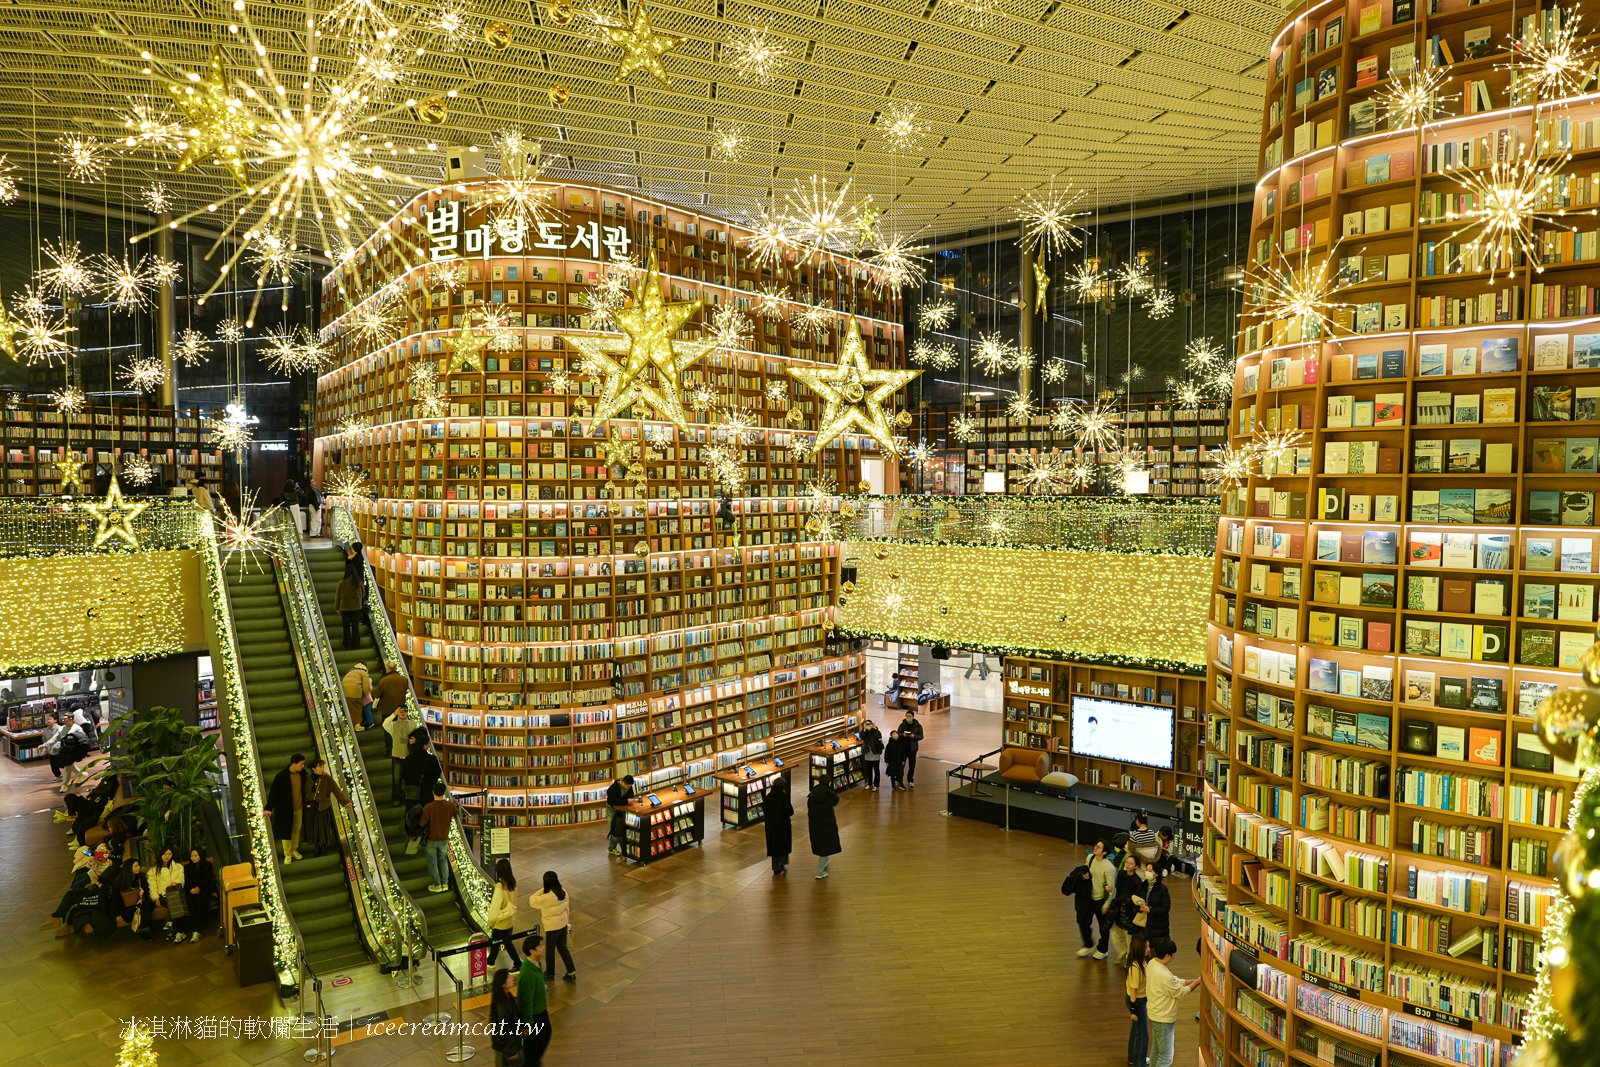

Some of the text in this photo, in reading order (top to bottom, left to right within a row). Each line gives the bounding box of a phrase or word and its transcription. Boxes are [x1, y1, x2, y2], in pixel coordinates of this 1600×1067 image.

[1326, 494, 1338, 513] D
[1483, 633, 1500, 654] D
[615, 664, 621, 677] A
[1190, 801, 1204, 823] B
[1186, 832, 1204, 843] 비소
[1304, 973, 1318, 984] B29
[1415, 1007, 1431, 1018] B30
